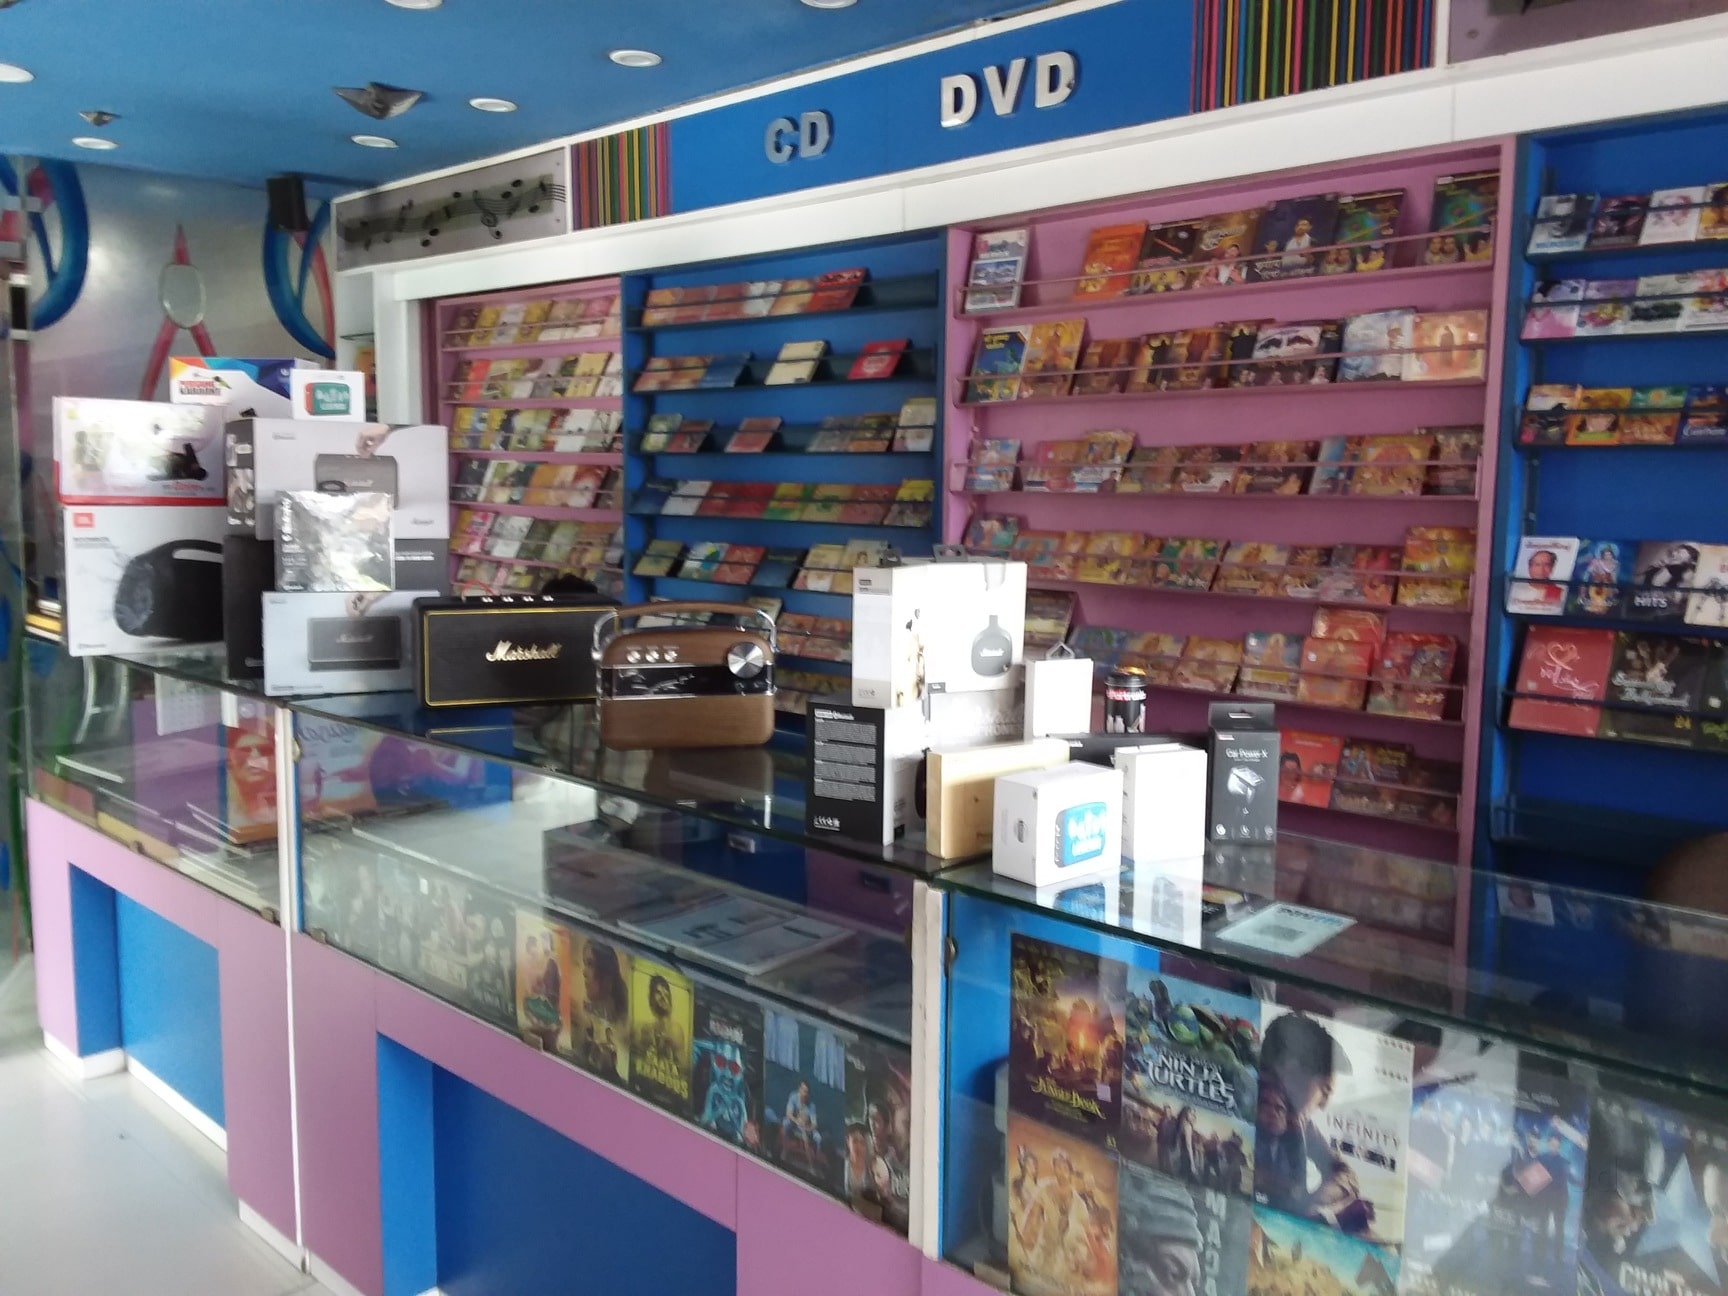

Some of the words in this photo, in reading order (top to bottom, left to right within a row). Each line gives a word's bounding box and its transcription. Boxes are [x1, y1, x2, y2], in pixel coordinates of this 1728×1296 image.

[765, 109, 834, 165] CD
[940, 50, 1077, 129] DVD
[485, 640, 563, 662] Marshall
[1144, 1059, 1237, 1110] TURTLES
[1157, 1053, 1226, 1093] NINJA
[1325, 1112, 1400, 1149] INFINITY
